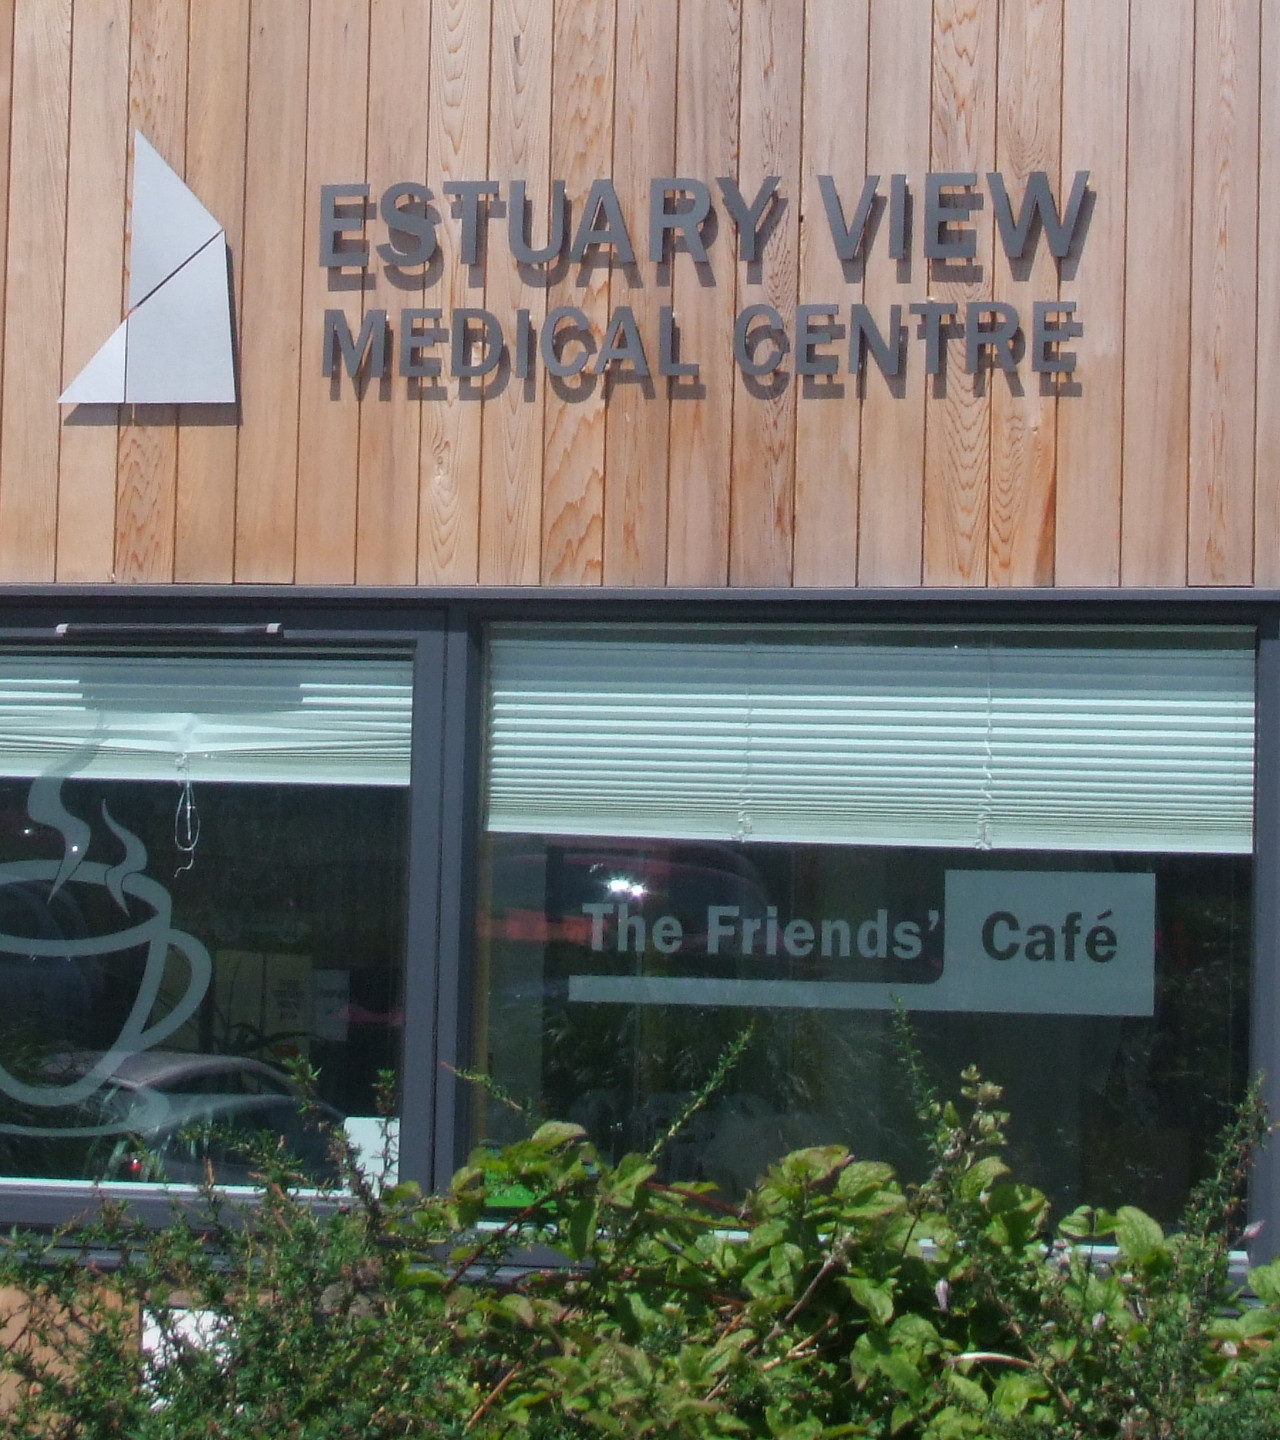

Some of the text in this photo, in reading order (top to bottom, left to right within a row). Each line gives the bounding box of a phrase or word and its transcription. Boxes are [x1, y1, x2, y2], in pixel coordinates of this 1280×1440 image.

[318, 170, 1091, 269] ESTUARY VIEW
[321, 300, 1078, 380] MEDICAL CENTRE
[581, 902, 683, 954] The
[980, 908, 1118, 963] Café
